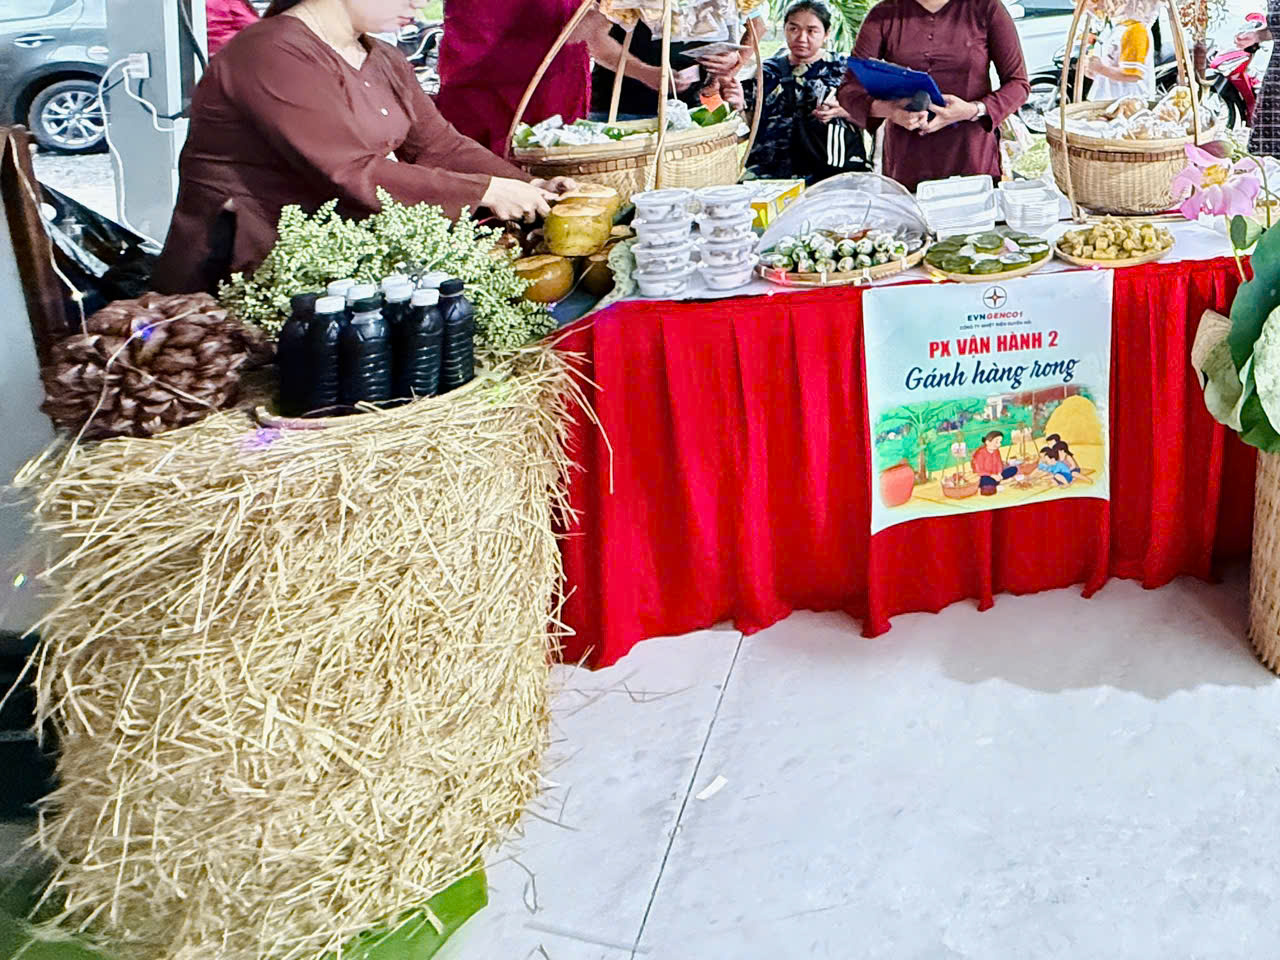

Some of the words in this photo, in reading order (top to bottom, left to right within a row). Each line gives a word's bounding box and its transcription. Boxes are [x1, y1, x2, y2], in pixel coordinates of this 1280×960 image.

[967, 311, 1024, 322] EVNGENCO1
[929, 340, 951, 359] PX
[956, 334, 991, 358] VẬN
[997, 331, 1042, 352] HÀNH
[1048, 330, 1059, 347] 2
[905, 362, 968, 390] Gánh
[972, 360, 1029, 389] hàng
[1030, 358, 1080, 383] rong
